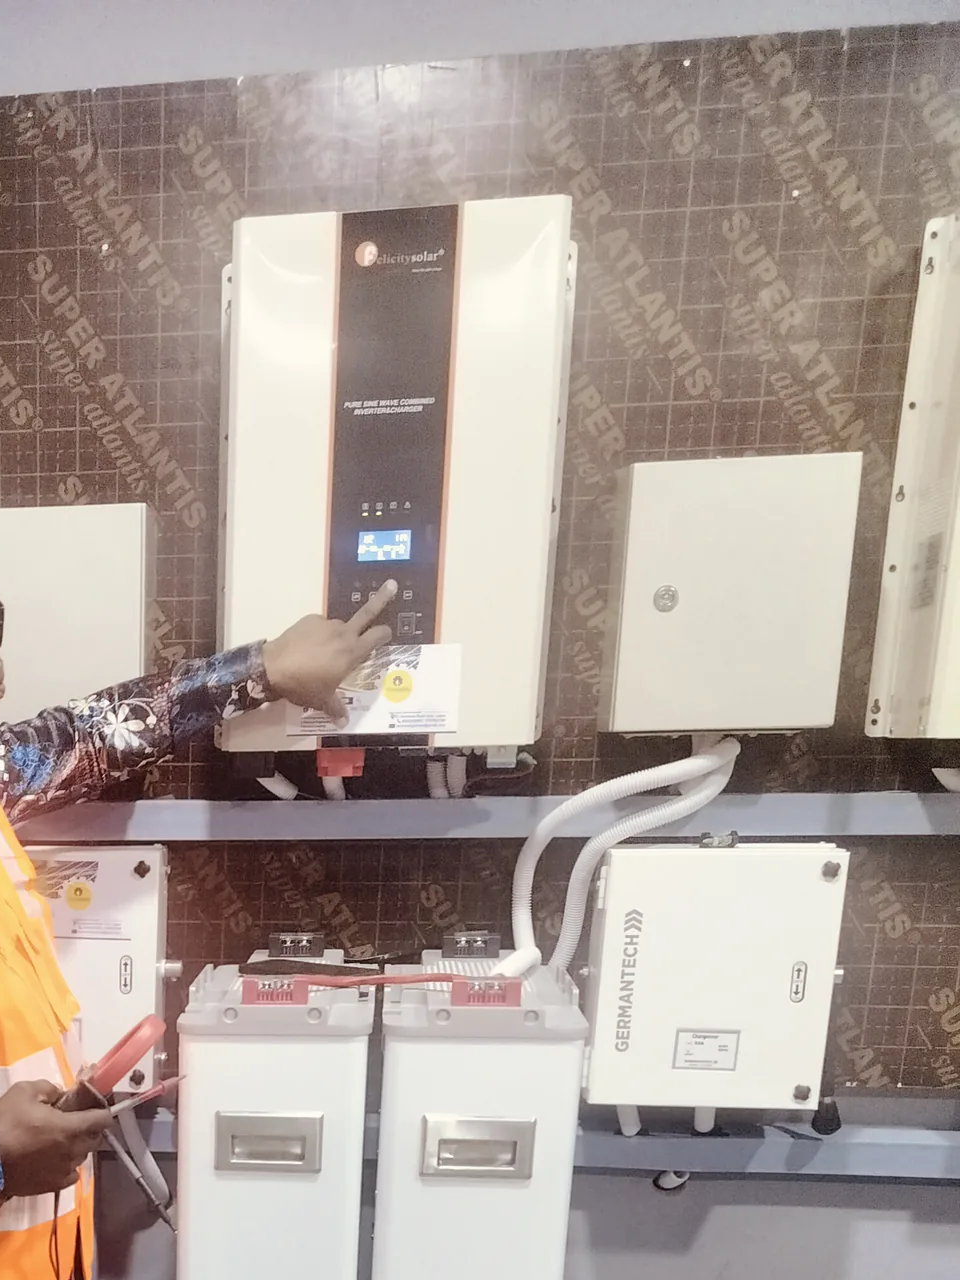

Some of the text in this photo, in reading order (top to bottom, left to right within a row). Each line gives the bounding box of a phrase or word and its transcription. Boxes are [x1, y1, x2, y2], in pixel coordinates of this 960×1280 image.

[26, 254, 107, 371] SUPER
[98, 371, 208, 530] ATLANTIS
[37, 328, 153, 496] super atlantis
[343, 400, 362, 409] PURE
[379, 398, 400, 407] WAVE
[400, 396, 435, 406] COMBINED
[614, 933, 641, 1053] GERMANTECH
